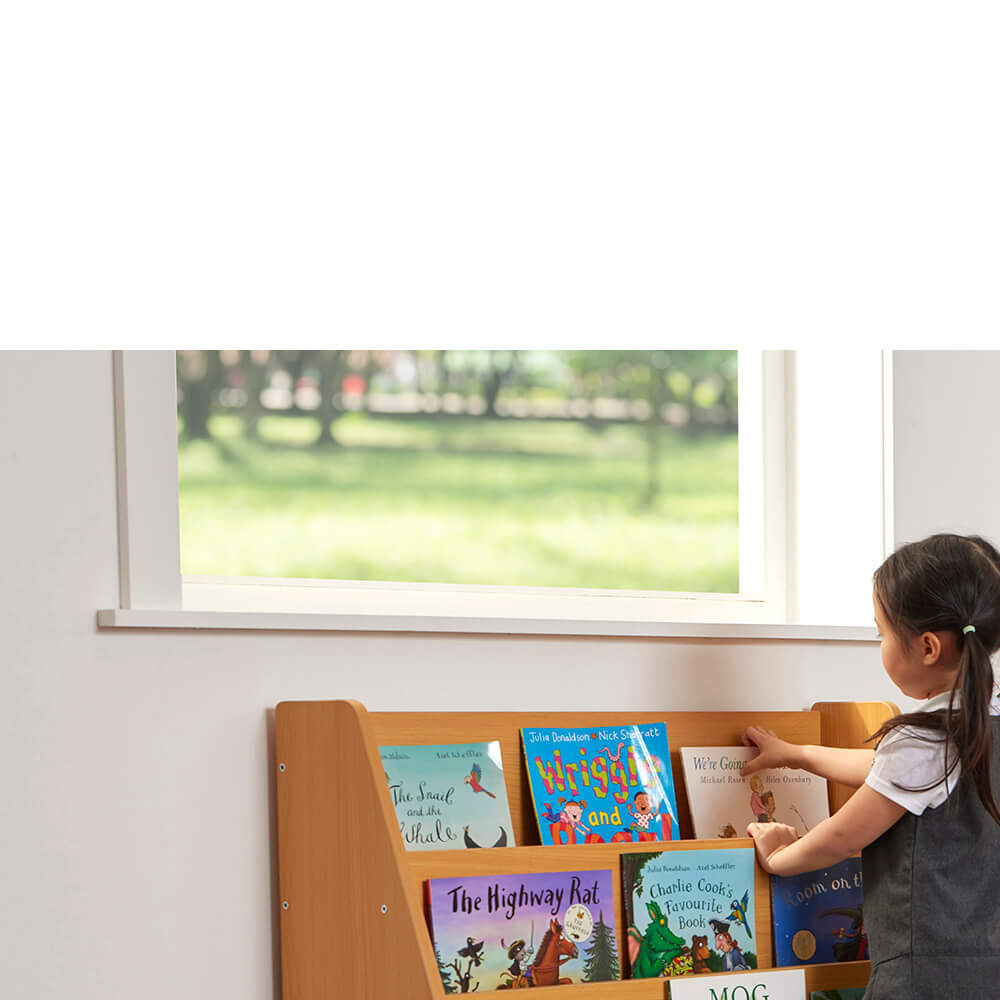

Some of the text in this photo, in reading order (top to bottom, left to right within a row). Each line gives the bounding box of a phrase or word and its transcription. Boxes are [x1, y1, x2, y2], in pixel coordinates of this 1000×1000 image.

[528, 731, 550, 743] Julia
[552, 731, 590, 742] Donaldson
[599, 731, 619, 741] Nick
[693, 756, 716, 770] We're
[700, 775, 726, 784] Michael
[765, 775, 781, 784] Helen
[389, 781, 455, 806] The Snail
[407, 805, 442, 816] and the
[588, 805, 622, 826] and
[649, 879, 693, 899] Charlie
[697, 878, 733, 898] Cook's
[831, 877, 851, 890] on
[447, 885, 482, 914] The
[487, 883, 564, 920] Highway
[569, 876, 600, 905] Rat
[664, 898, 723, 915] Favourite
[678, 914, 707, 930] Book
